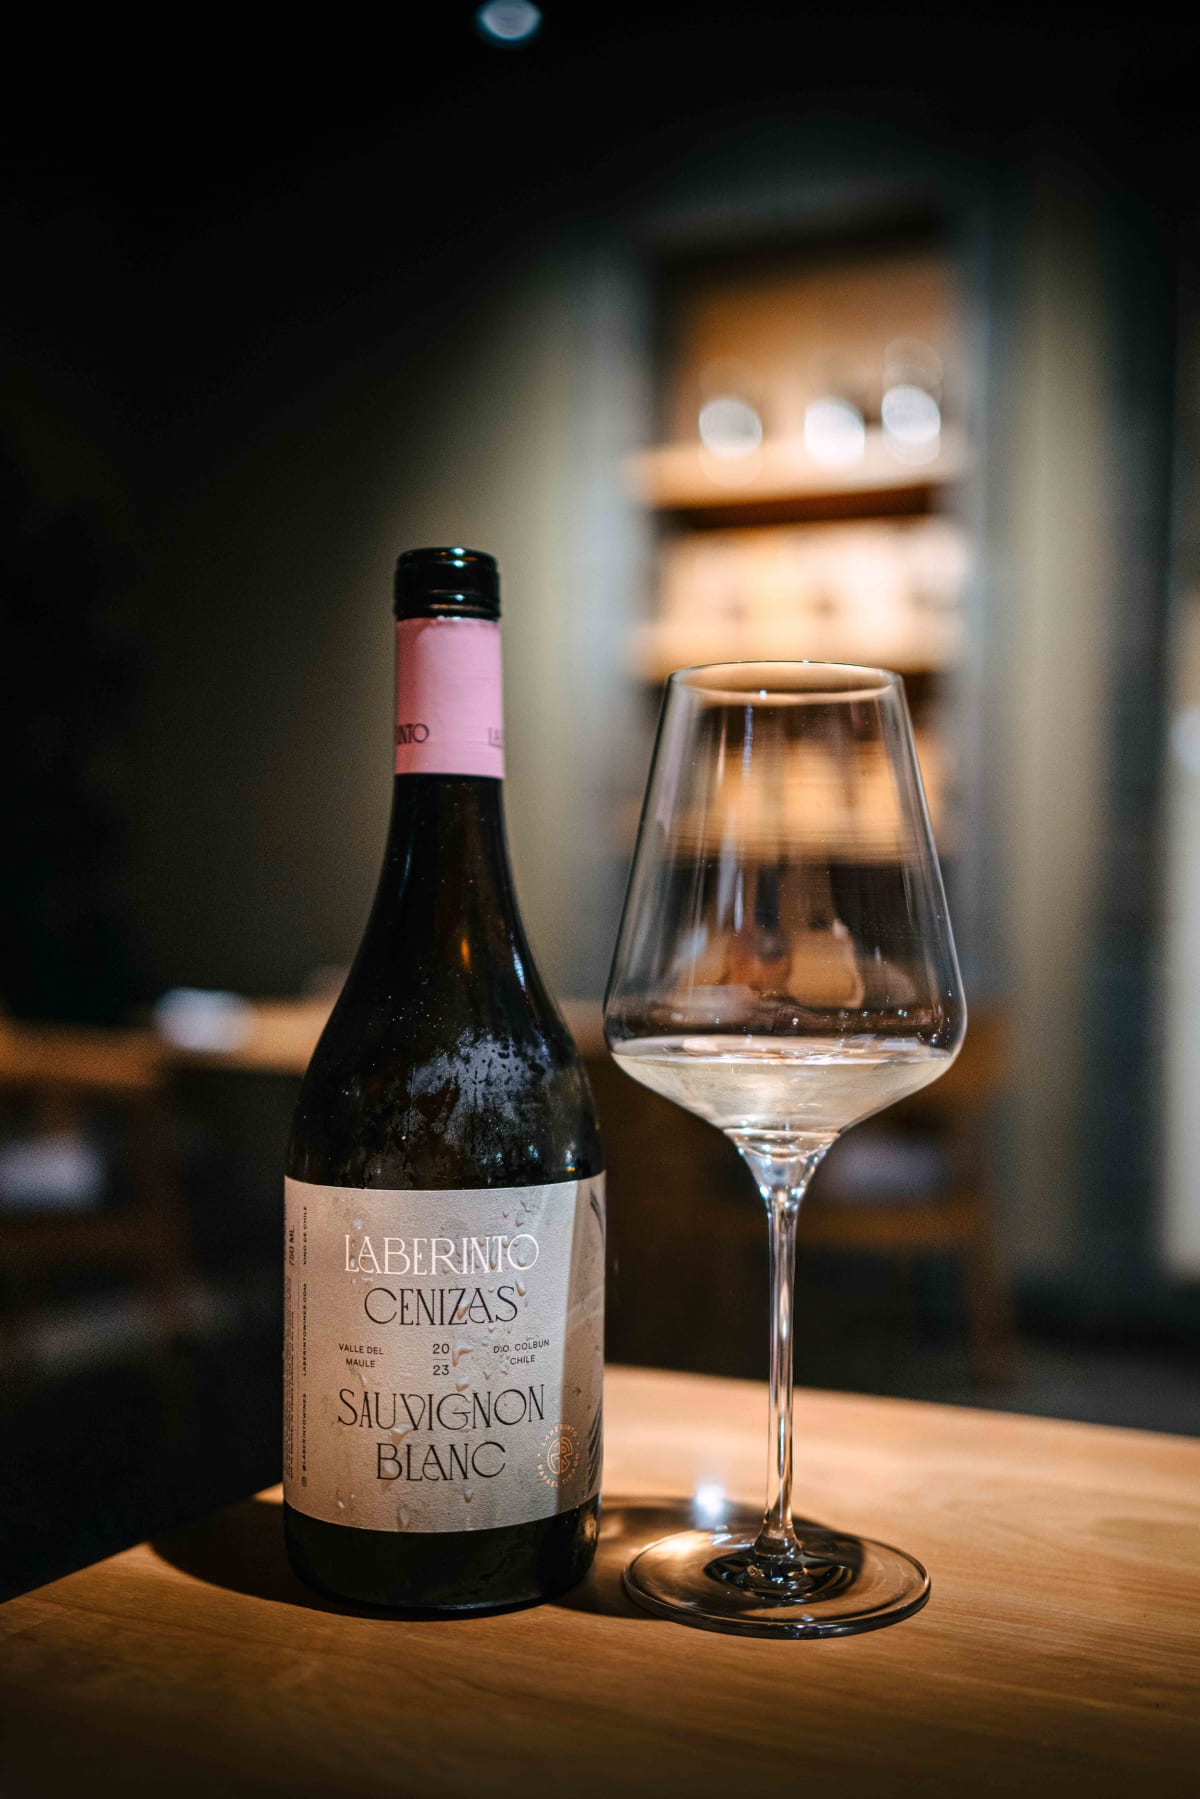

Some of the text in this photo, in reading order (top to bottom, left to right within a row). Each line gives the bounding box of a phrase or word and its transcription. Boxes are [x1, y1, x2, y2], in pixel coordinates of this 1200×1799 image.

[344, 1234, 540, 1276] LABERINTO
[364, 1286, 518, 1326] CENIZAS
[338, 1343, 384, 1355] VALLE DEL
[432, 1343, 450, 1355] 20
[345, 1358, 376, 1368] MAULE
[510, 1355, 536, 1365] CHILE
[432, 1365, 450, 1376] 23
[338, 1384, 545, 1431] SAUVIGNON
[376, 1441, 506, 1481] BLANC
